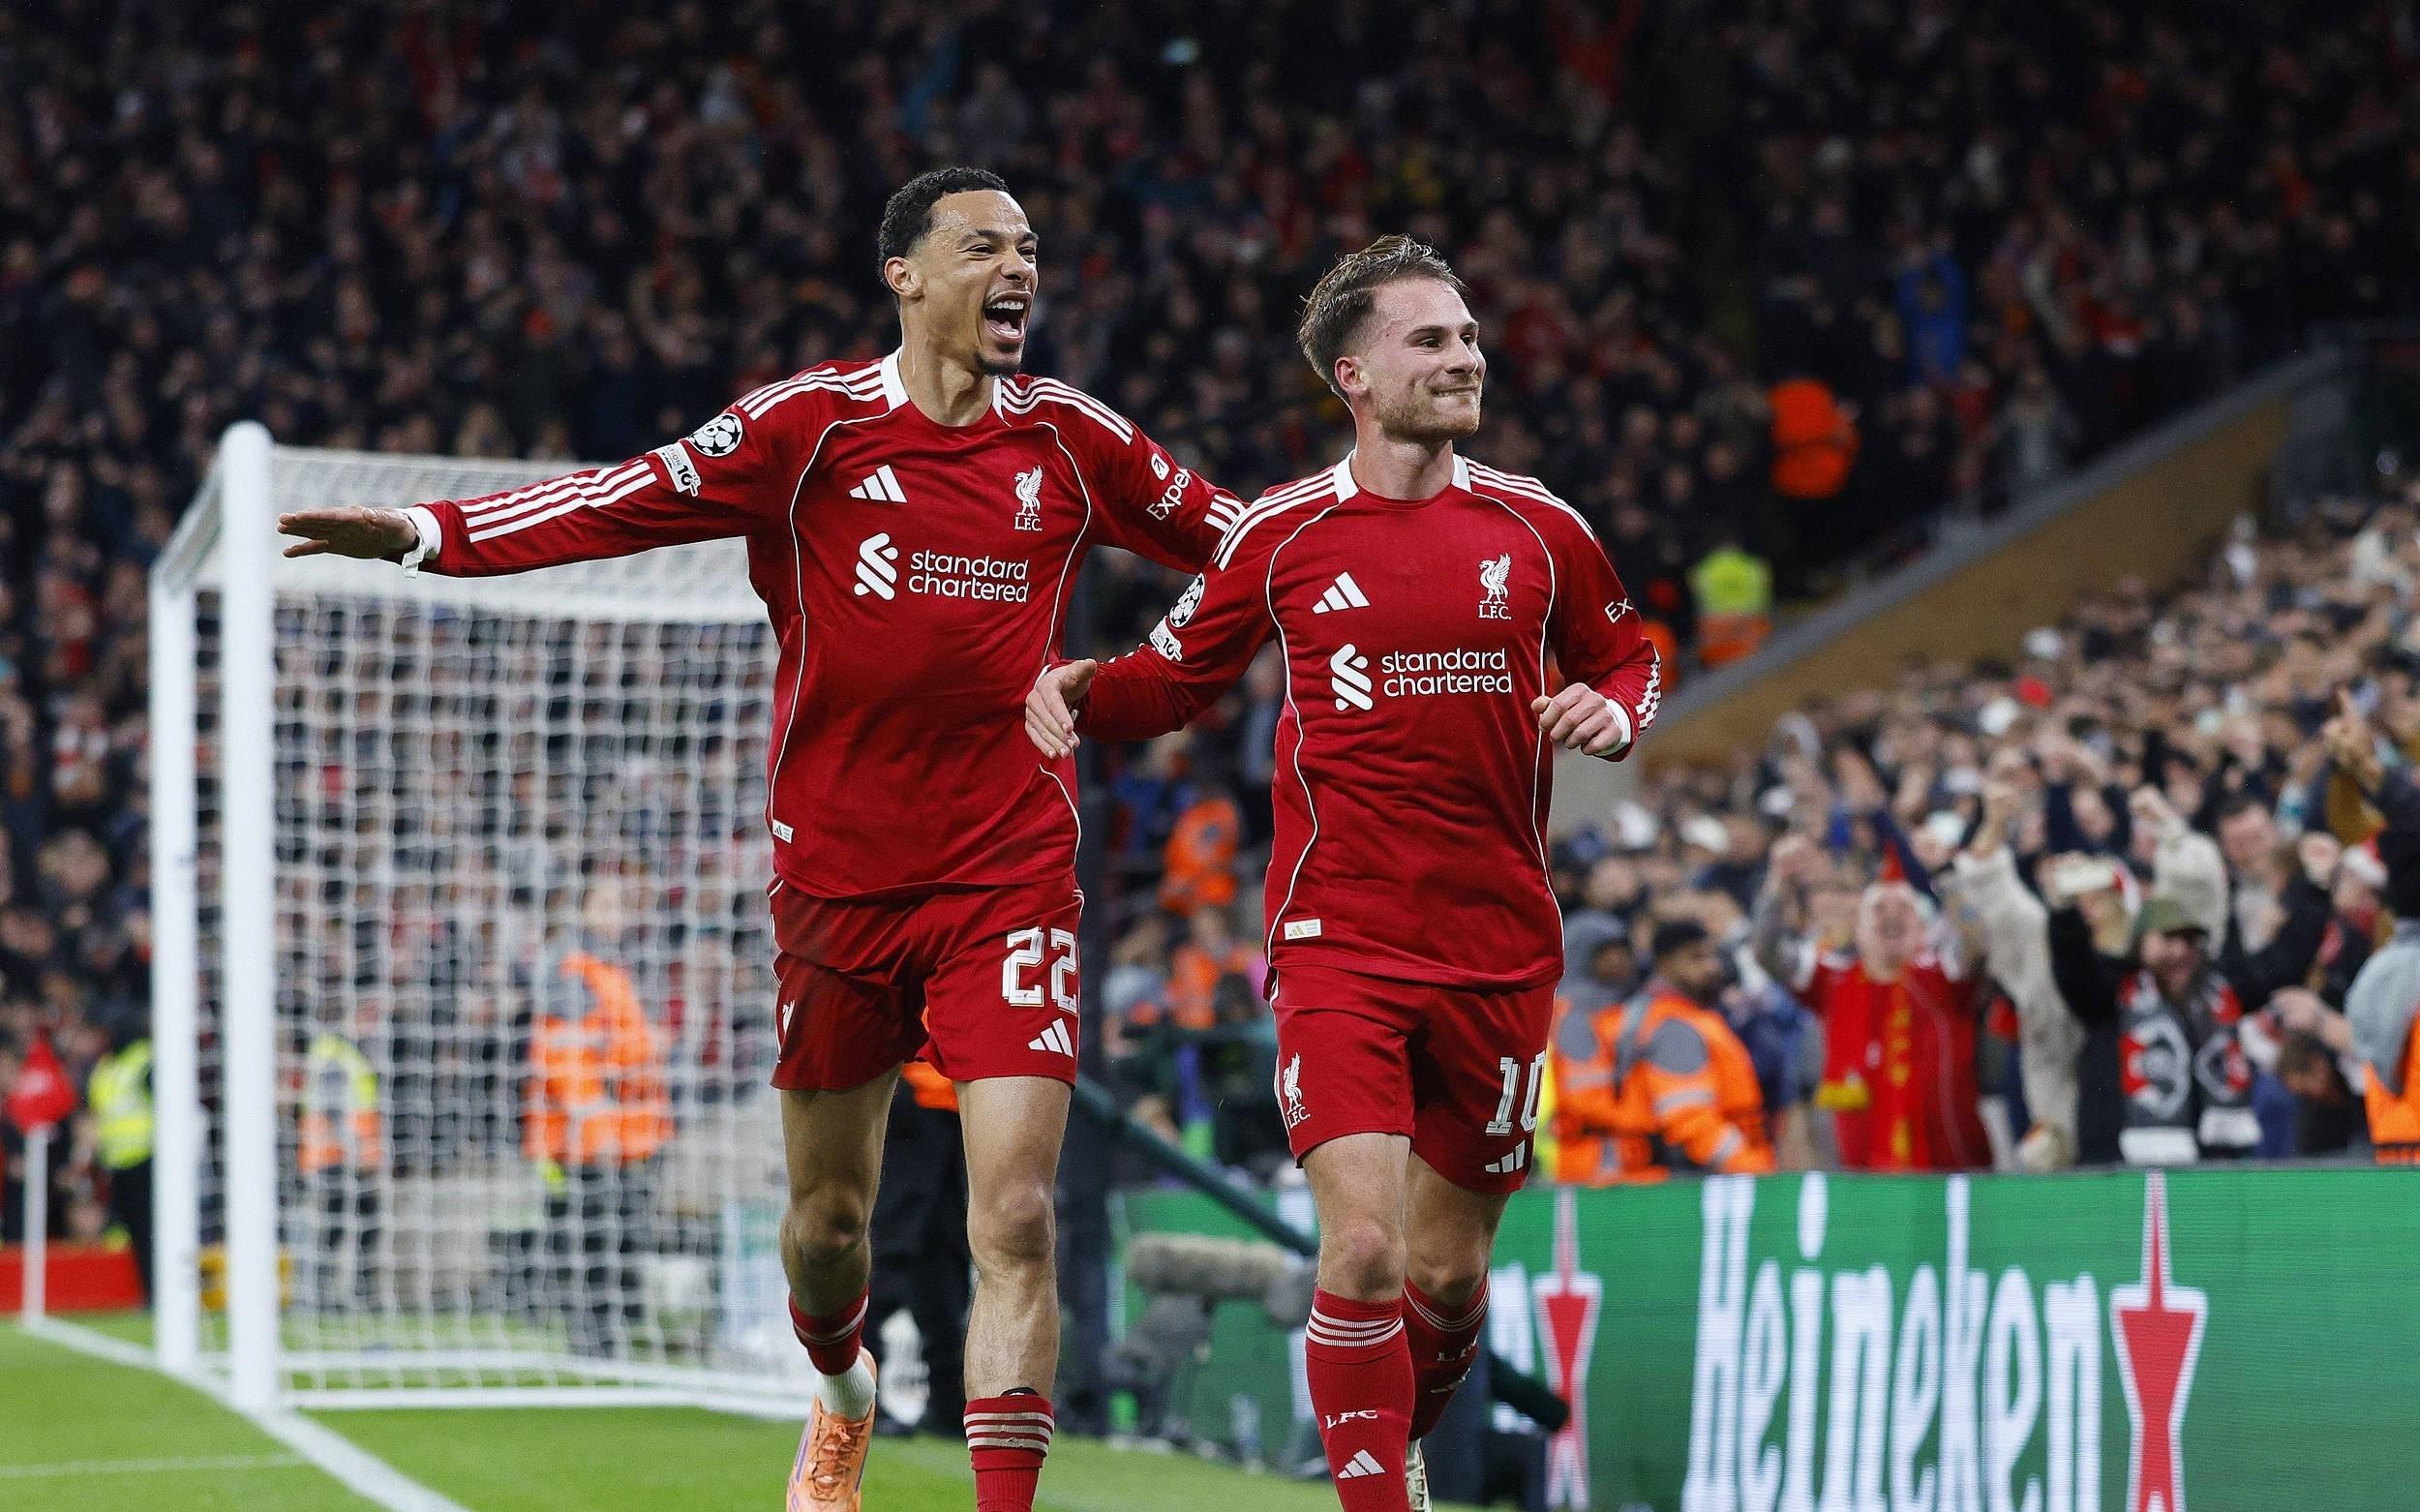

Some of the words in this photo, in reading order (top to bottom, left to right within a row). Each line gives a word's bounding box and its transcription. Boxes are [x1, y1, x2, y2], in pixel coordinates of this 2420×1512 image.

[1146, 469, 1192, 521] Expe
[910, 549, 1029, 581] standard
[907, 573, 1029, 603] chartered
[1380, 647, 1506, 674] standard
[1382, 671, 1513, 698] chartered
[1001, 925, 1079, 1017] 22
[1485, 1050, 1546, 1136] 10
[1680, 1172, 2104, 1512] Heineken
